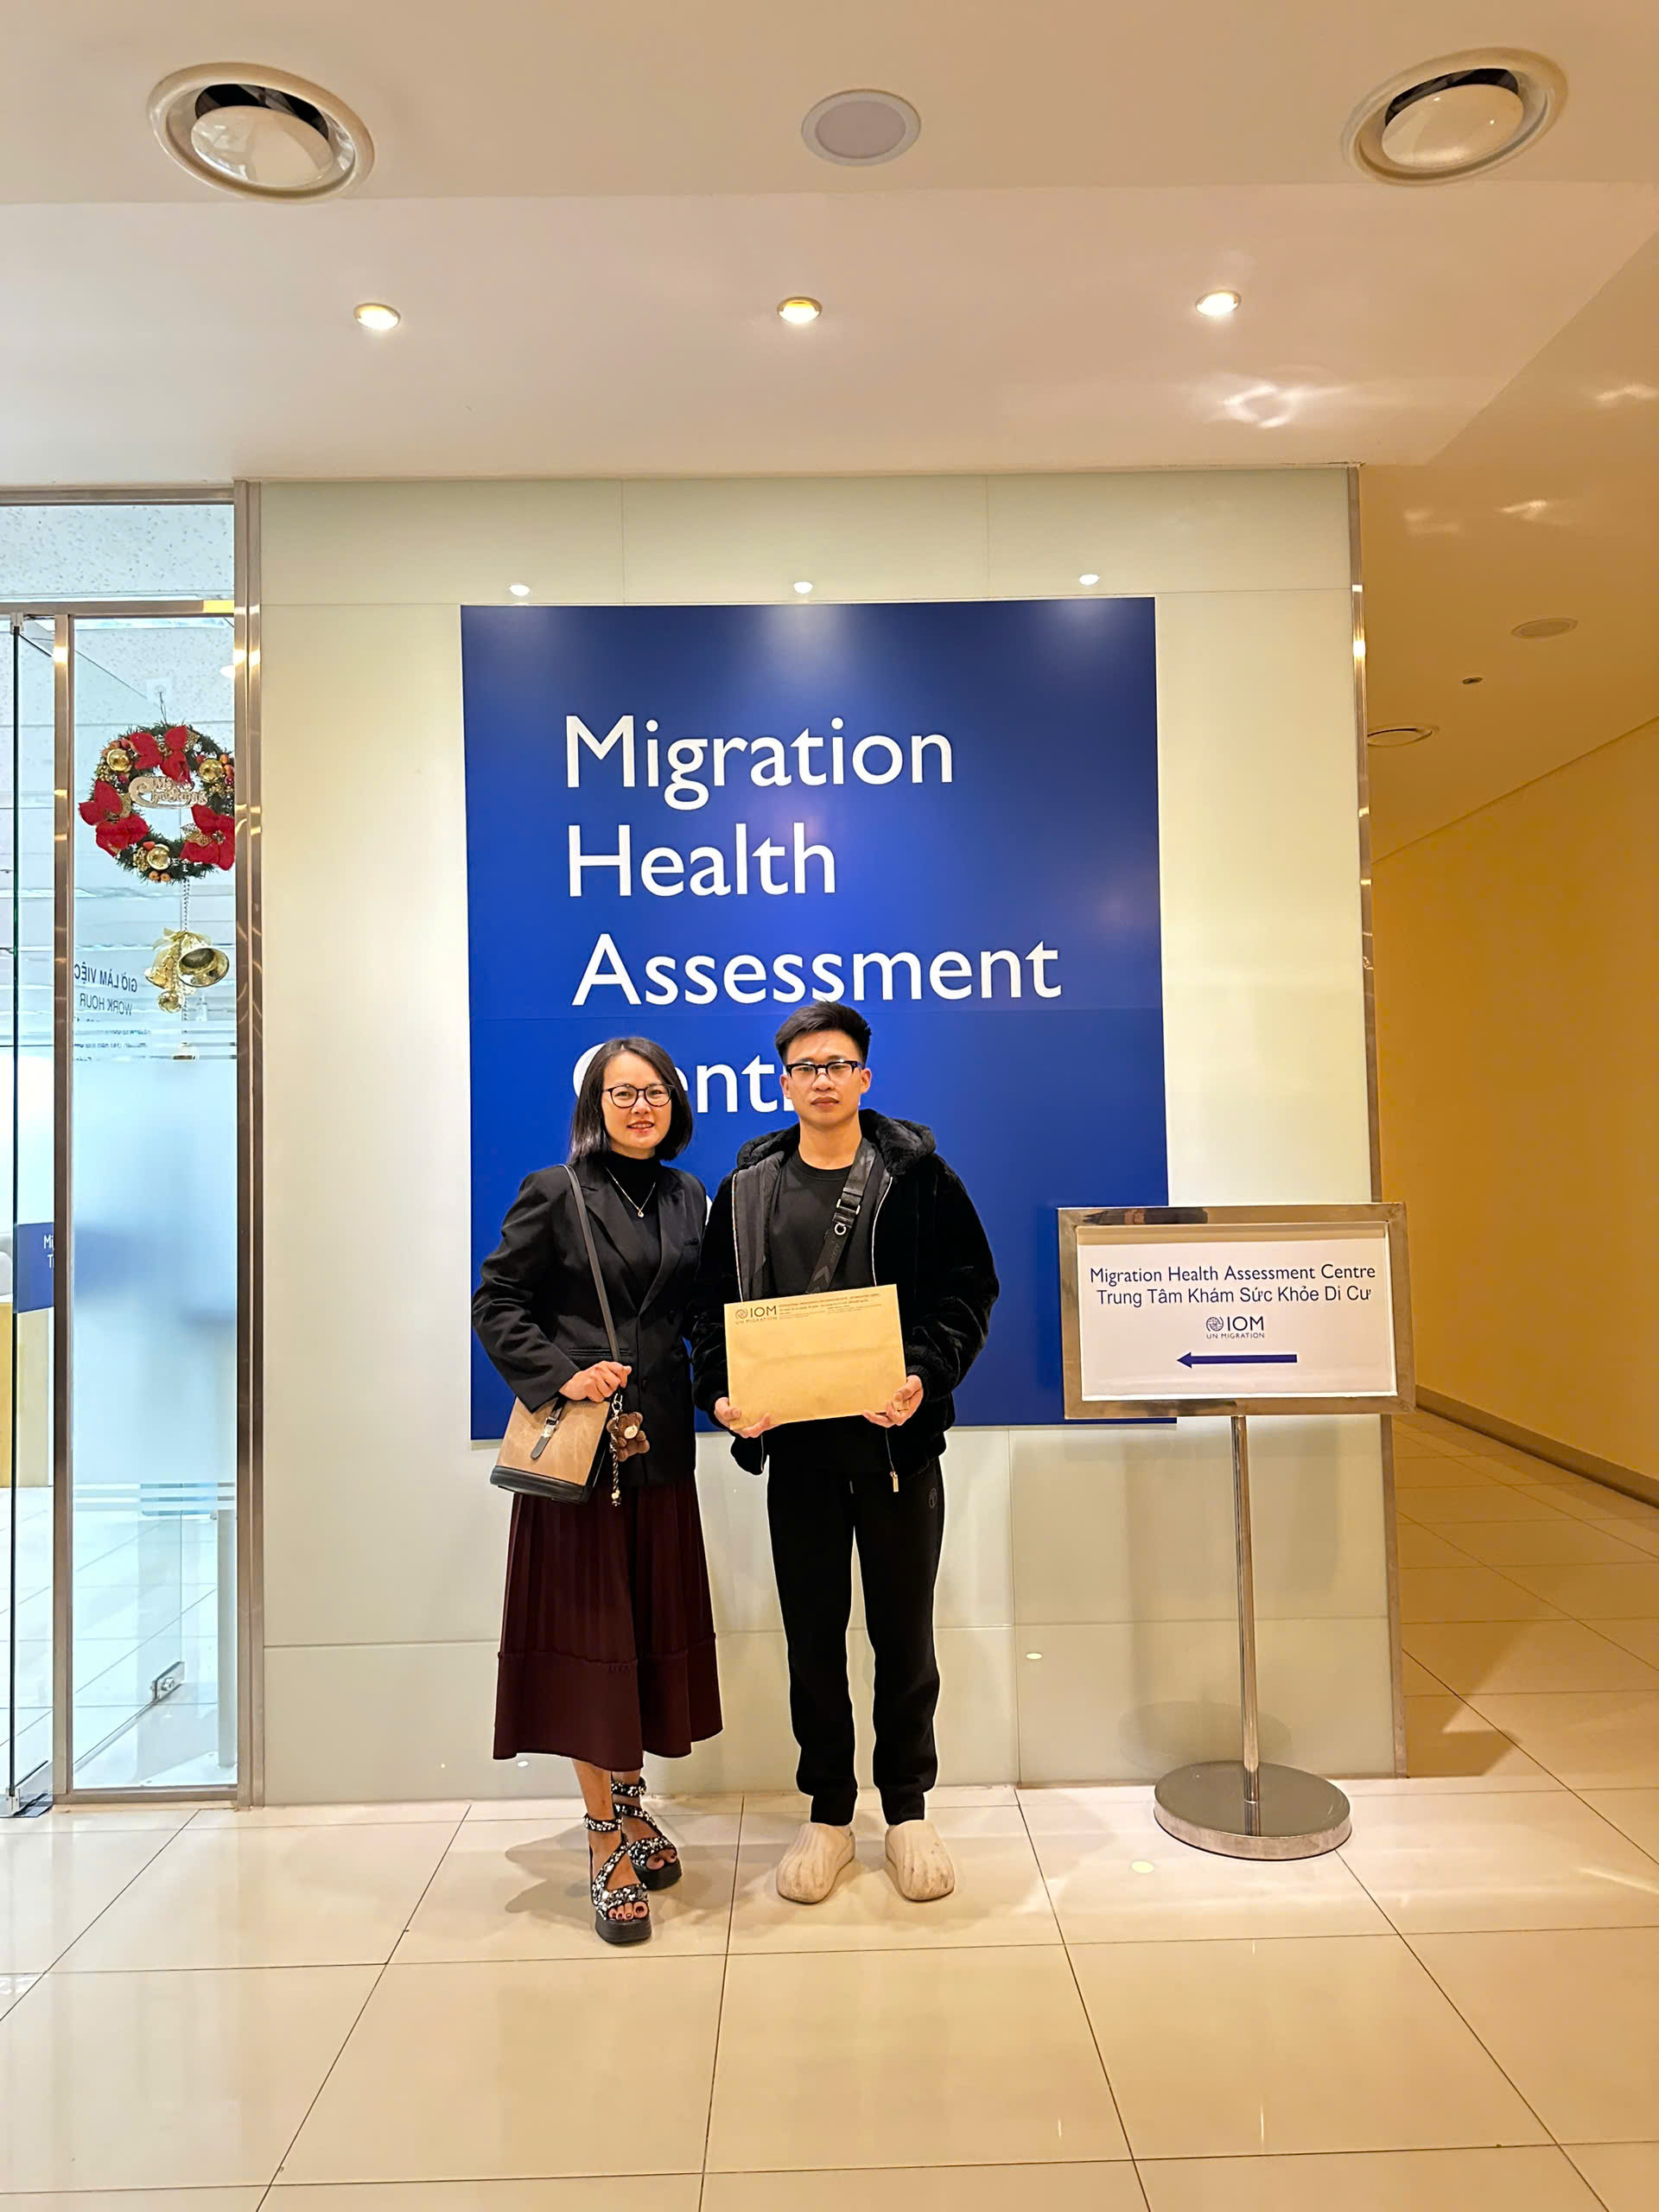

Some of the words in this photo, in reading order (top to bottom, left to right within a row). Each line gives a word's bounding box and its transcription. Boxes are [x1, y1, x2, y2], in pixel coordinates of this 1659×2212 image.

[566, 715, 953, 810] Migration
[569, 822, 836, 898] Health
[571, 933, 1062, 1006] Assessment
[1090, 1268, 1162, 1287] Migration
[1168, 1266, 1218, 1281] Health
[1224, 1265, 1316, 1281] Assessment
[1321, 1263, 1376, 1279] Centre
[1096, 1289, 1142, 1308] Trung
[1147, 1288, 1183, 1304] Tâm
[1188, 1287, 1235, 1303] Khám
[1240, 1287, 1273, 1302] Sức
[1277, 1285, 1319, 1302] Khỏe
[1325, 1285, 1341, 1301] Di
[1346, 1285, 1372, 1300] Cư
[750, 1305, 777, 1318] IOM
[1227, 1316, 1264, 1332] IOM
